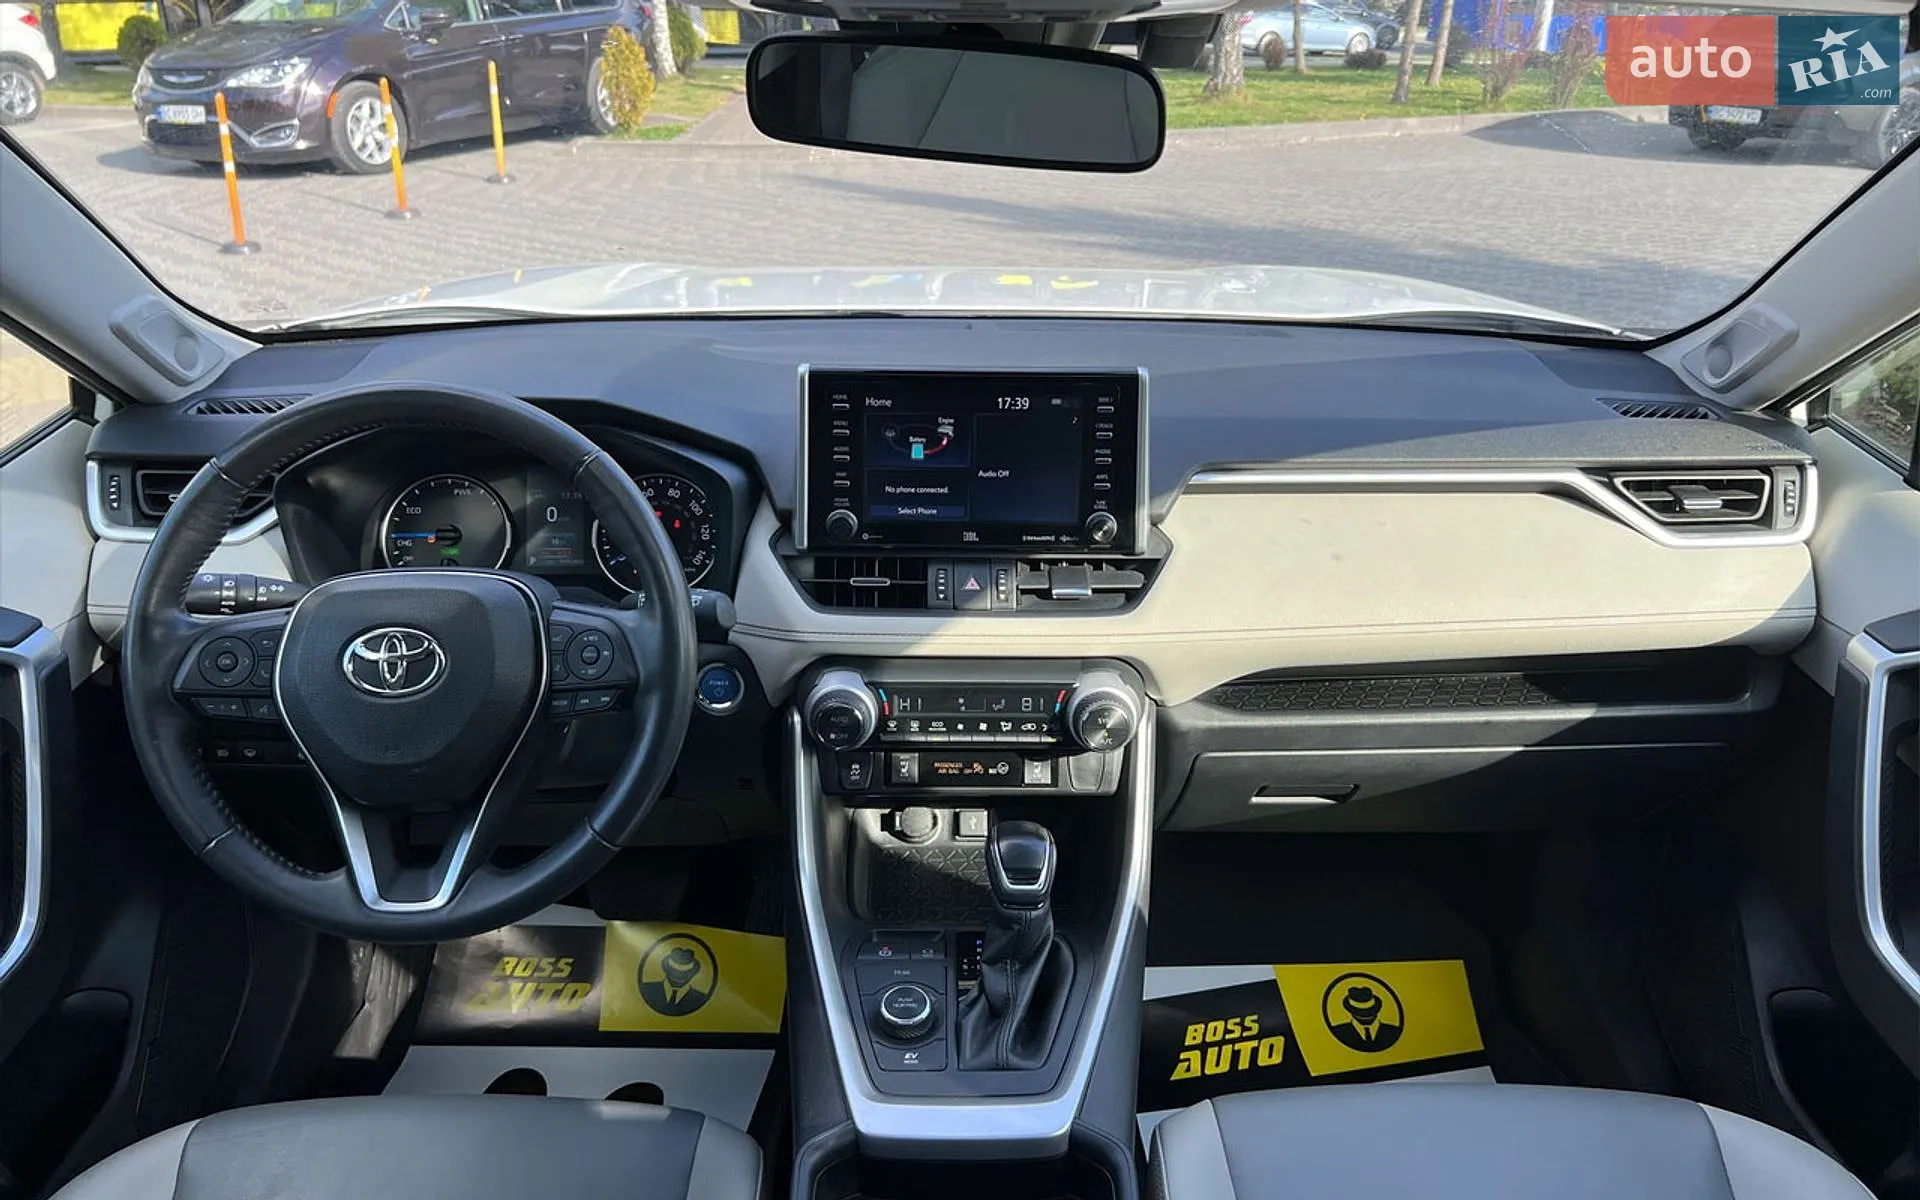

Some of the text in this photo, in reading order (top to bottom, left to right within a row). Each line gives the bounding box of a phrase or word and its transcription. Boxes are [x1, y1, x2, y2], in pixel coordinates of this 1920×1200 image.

[865, 397, 892, 407] Home
[998, 397, 1029, 410] 17:39
[978, 469, 997, 477] Audio
[668, 487, 681, 498] 80
[896, 486, 915, 495] phone
[406, 506, 422, 515] ECO
[547, 506, 558, 522] 0
[689, 500, 703, 516] 100
[701, 523, 710, 540] 120
[692, 549, 707, 565] 140
[1184, 1014, 1259, 1047] BOSS
[904, 1052, 919, 1060] EV
[1169, 1035, 1285, 1081] AUTO
